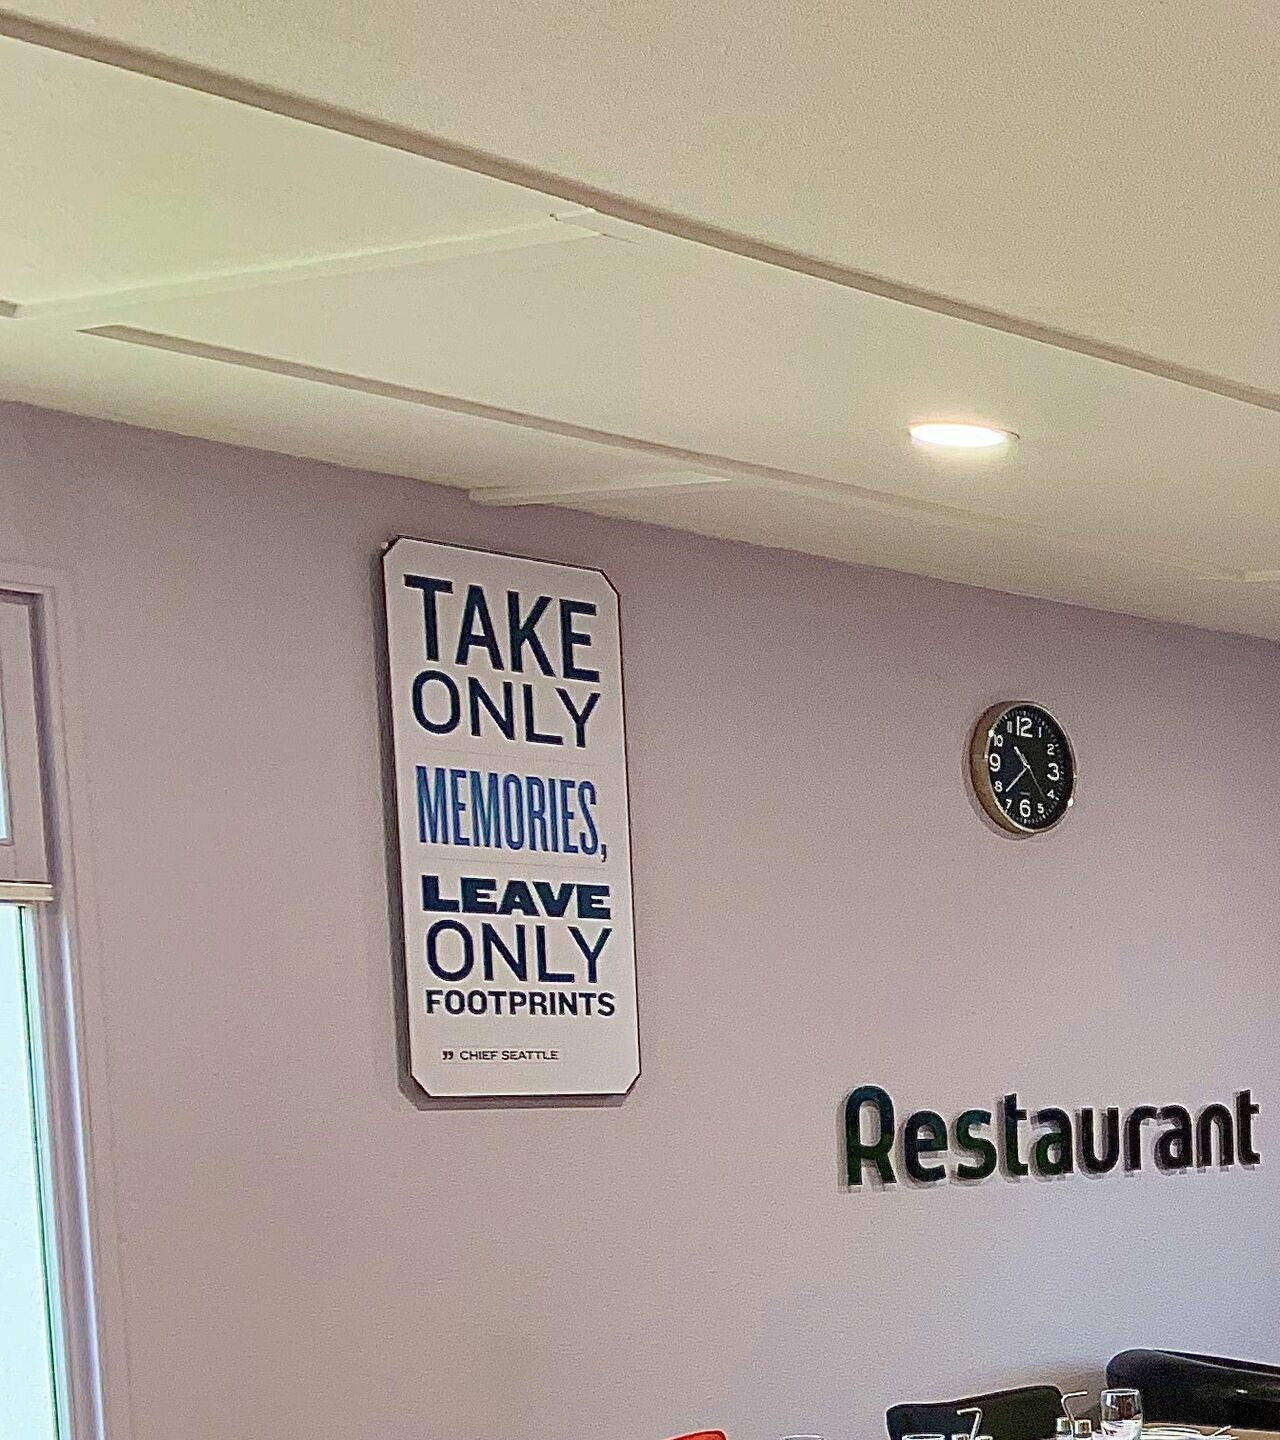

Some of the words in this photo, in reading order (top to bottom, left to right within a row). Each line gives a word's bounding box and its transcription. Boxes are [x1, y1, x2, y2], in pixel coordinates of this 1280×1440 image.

[404, 574, 600, 683] TAKE
[411, 669, 600, 749] ONLY
[1016, 716, 1033, 738] 12
[993, 735, 1004, 747] 10
[1046, 743, 1055, 755] 2
[989, 753, 1001, 772] 9
[1046, 763, 1060, 781] 3
[994, 781, 1003, 792] 8
[1046, 788, 1055, 799] 4
[415, 765, 608, 863] MEMORIES,
[1004, 799, 1012, 813] 7
[1019, 799, 1031, 818] 6
[1036, 802, 1045, 814] 5
[421, 874, 612, 920] LEAVE
[426, 919, 612, 984] ONLY
[426, 989, 616, 1018] FOOTPRINTS
[459, 1050, 499, 1061] CHIEF
[501, 1050, 560, 1061] SEATTLE
[843, 1085, 1261, 1187] Restaurant
